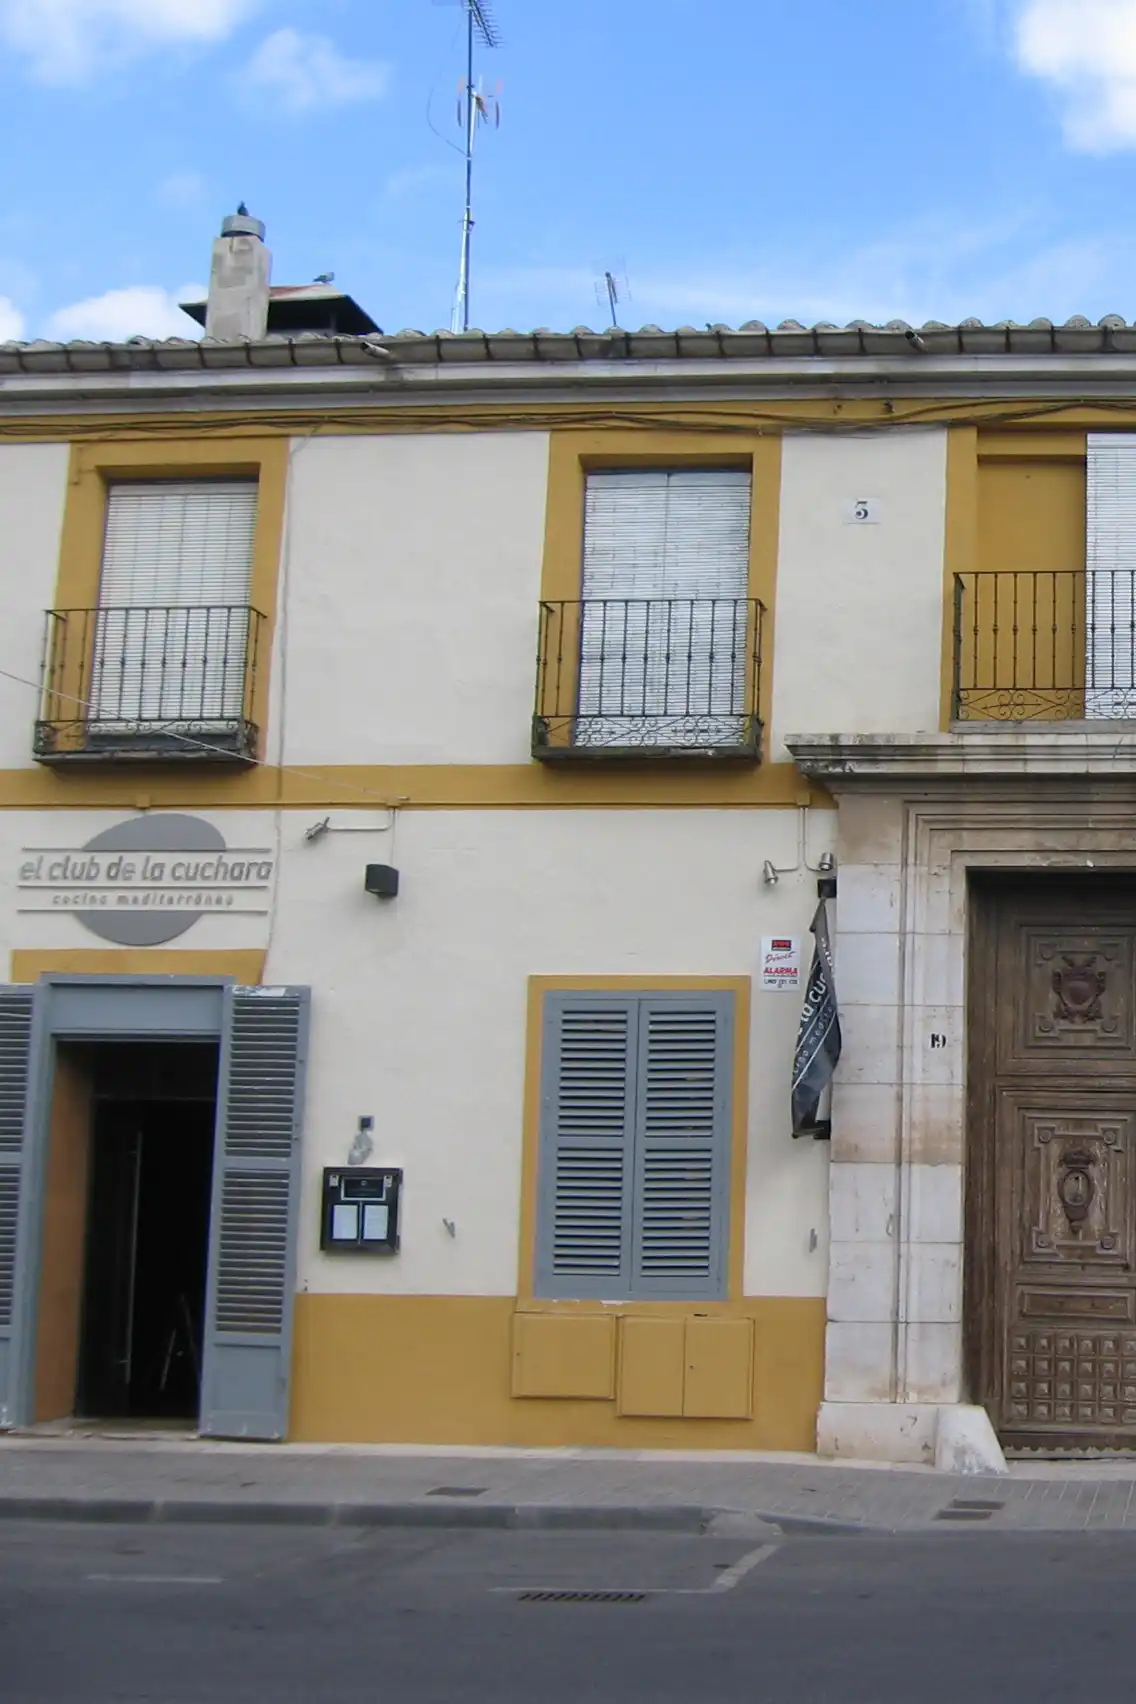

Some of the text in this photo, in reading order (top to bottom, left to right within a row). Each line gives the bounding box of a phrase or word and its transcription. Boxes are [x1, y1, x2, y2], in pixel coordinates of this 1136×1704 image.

[19, 854, 274, 881] el club de la cuchara
